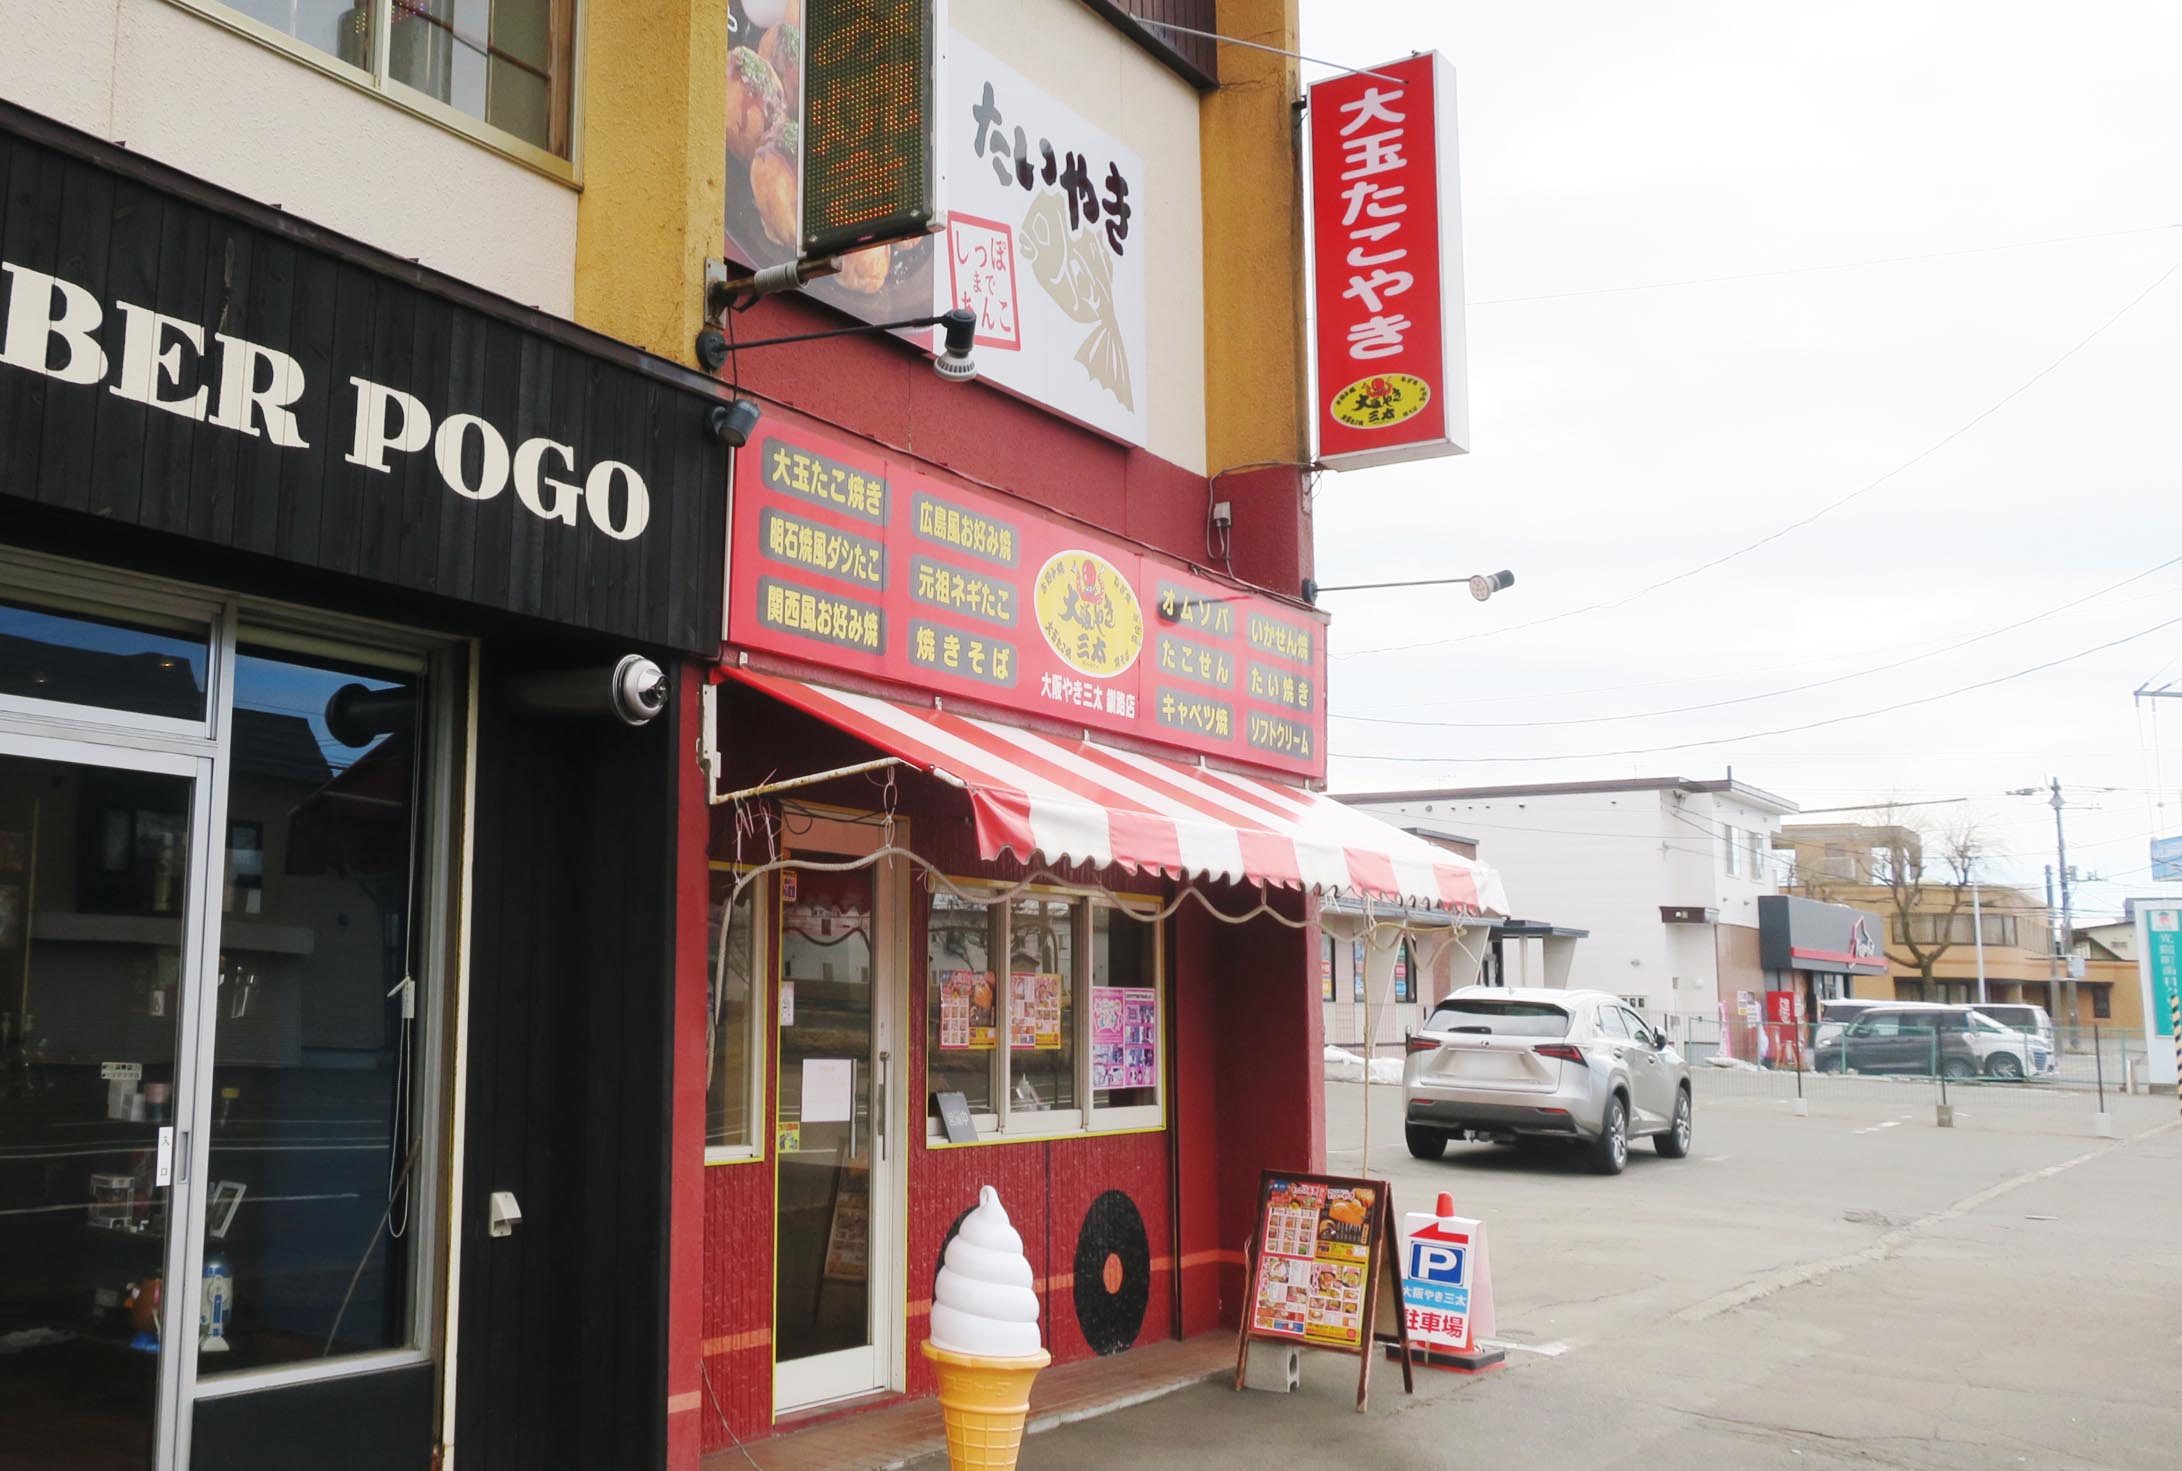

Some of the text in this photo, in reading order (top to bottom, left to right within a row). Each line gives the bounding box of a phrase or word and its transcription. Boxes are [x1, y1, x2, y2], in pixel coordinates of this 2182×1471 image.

[973, 81, 1131, 256] たいやき
[1340, 88, 1414, 360] 大玉たこやき
[973, 271, 995, 295] まで
[0, 261, 650, 541] BER POGO
[772, 448, 881, 515] 大玉たこ焼き
[769, 516, 880, 582] 明石焼風ダシたこ
[919, 501, 1012, 561] 広島風お好み焼
[918, 564, 1010, 620] 元祖ネギたこ
[1162, 588, 1229, 633] オムソバ
[767, 585, 879, 647] 関西風お好み焼
[916, 626, 1010, 680] 焼きそば
[1162, 640, 1229, 684] たこせん
[1251, 619, 1309, 661] いかせん焼
[1041, 671, 1103, 711] 大阪やき三太
[1251, 668, 1309, 707] たい焼き
[1162, 693, 1228, 736] キャベツ焼
[1251, 717, 1309, 756] ソフトクリーム
[161, 1135, 170, 1177] 入口
[1418, 1245, 1458, 1279] P
